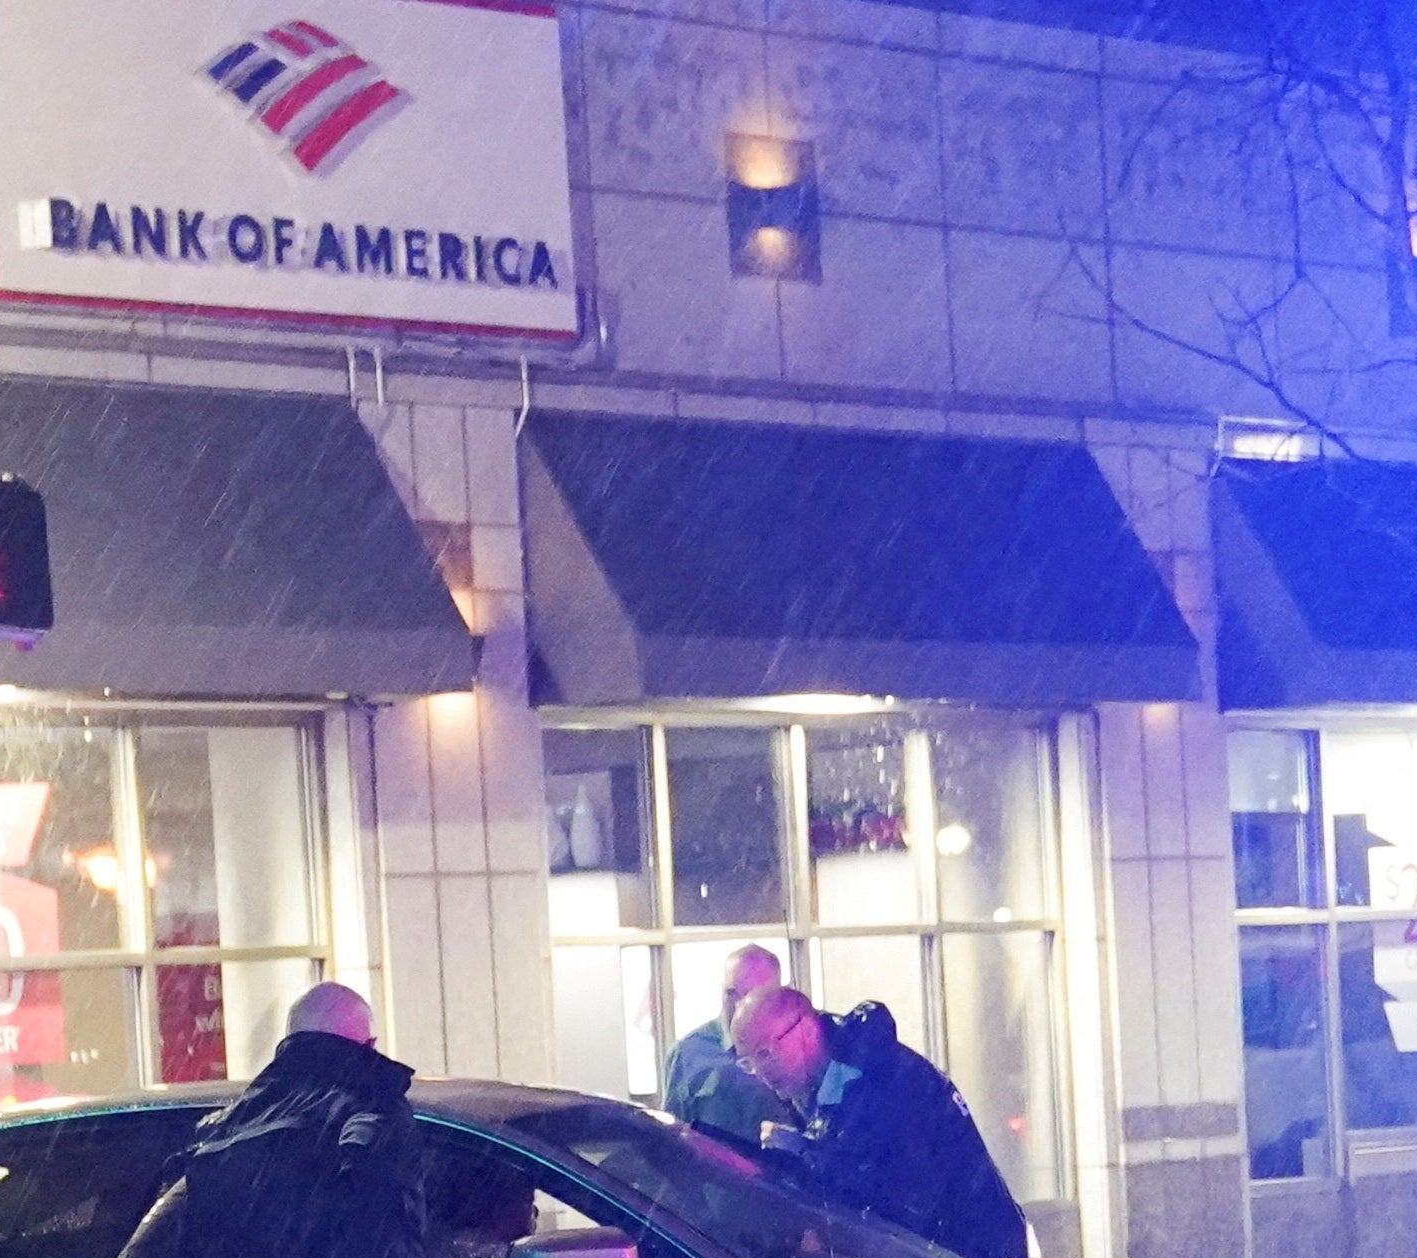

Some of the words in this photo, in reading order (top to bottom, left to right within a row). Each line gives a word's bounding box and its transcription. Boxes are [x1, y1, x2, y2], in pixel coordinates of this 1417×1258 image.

[49, 196, 208, 262] BANK
[227, 213, 295, 265] OF
[313, 221, 559, 289] AMERICA
